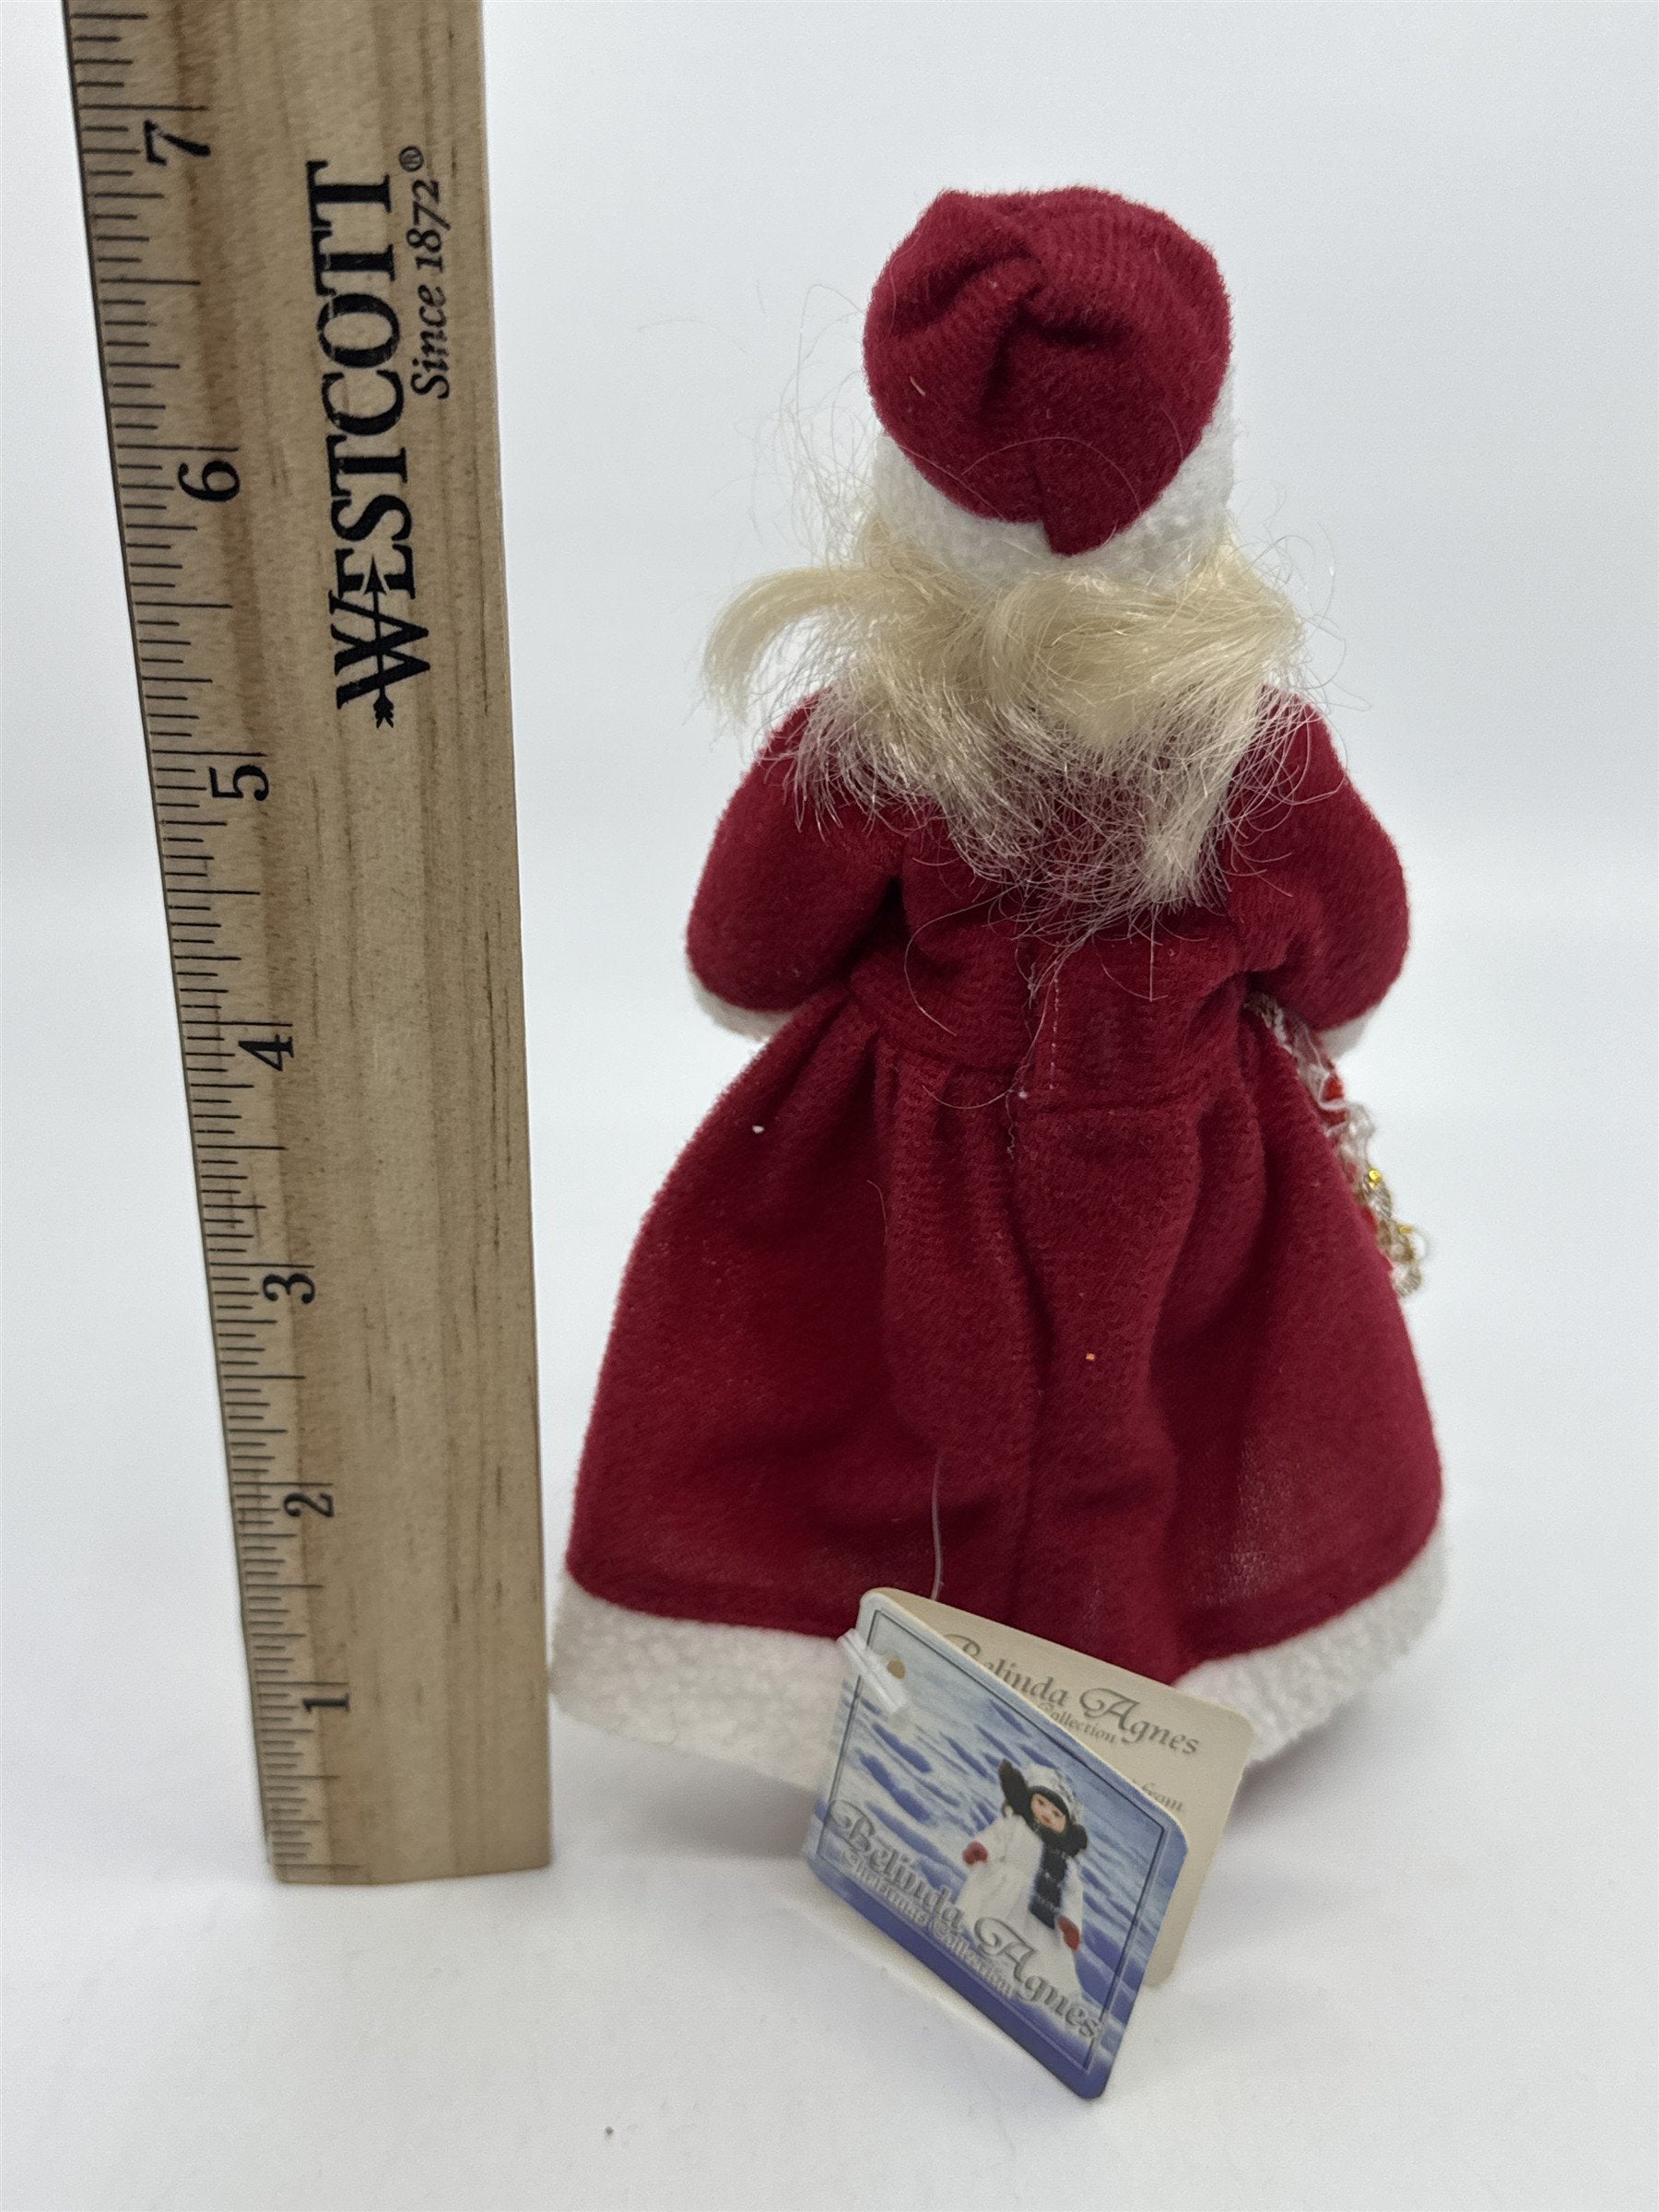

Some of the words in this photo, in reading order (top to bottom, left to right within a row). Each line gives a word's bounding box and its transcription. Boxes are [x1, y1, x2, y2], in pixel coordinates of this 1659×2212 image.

[143, 120, 211, 167] 7
[410, 284, 451, 400] Since
[306, 159, 431, 710] WESTCOTT
[177, 459, 241, 503] 6
[207, 763, 271, 801] 5
[238, 1034, 295, 1072] 4
[262, 1272, 317, 1305] 3
[283, 1491, 335, 1519] 2
[302, 1692, 351, 1714] 1
[1077, 1687, 1201, 1756] Agnes
[829, 1798, 967, 1936] Belinda
[972, 1916, 1100, 2039] Agnes
